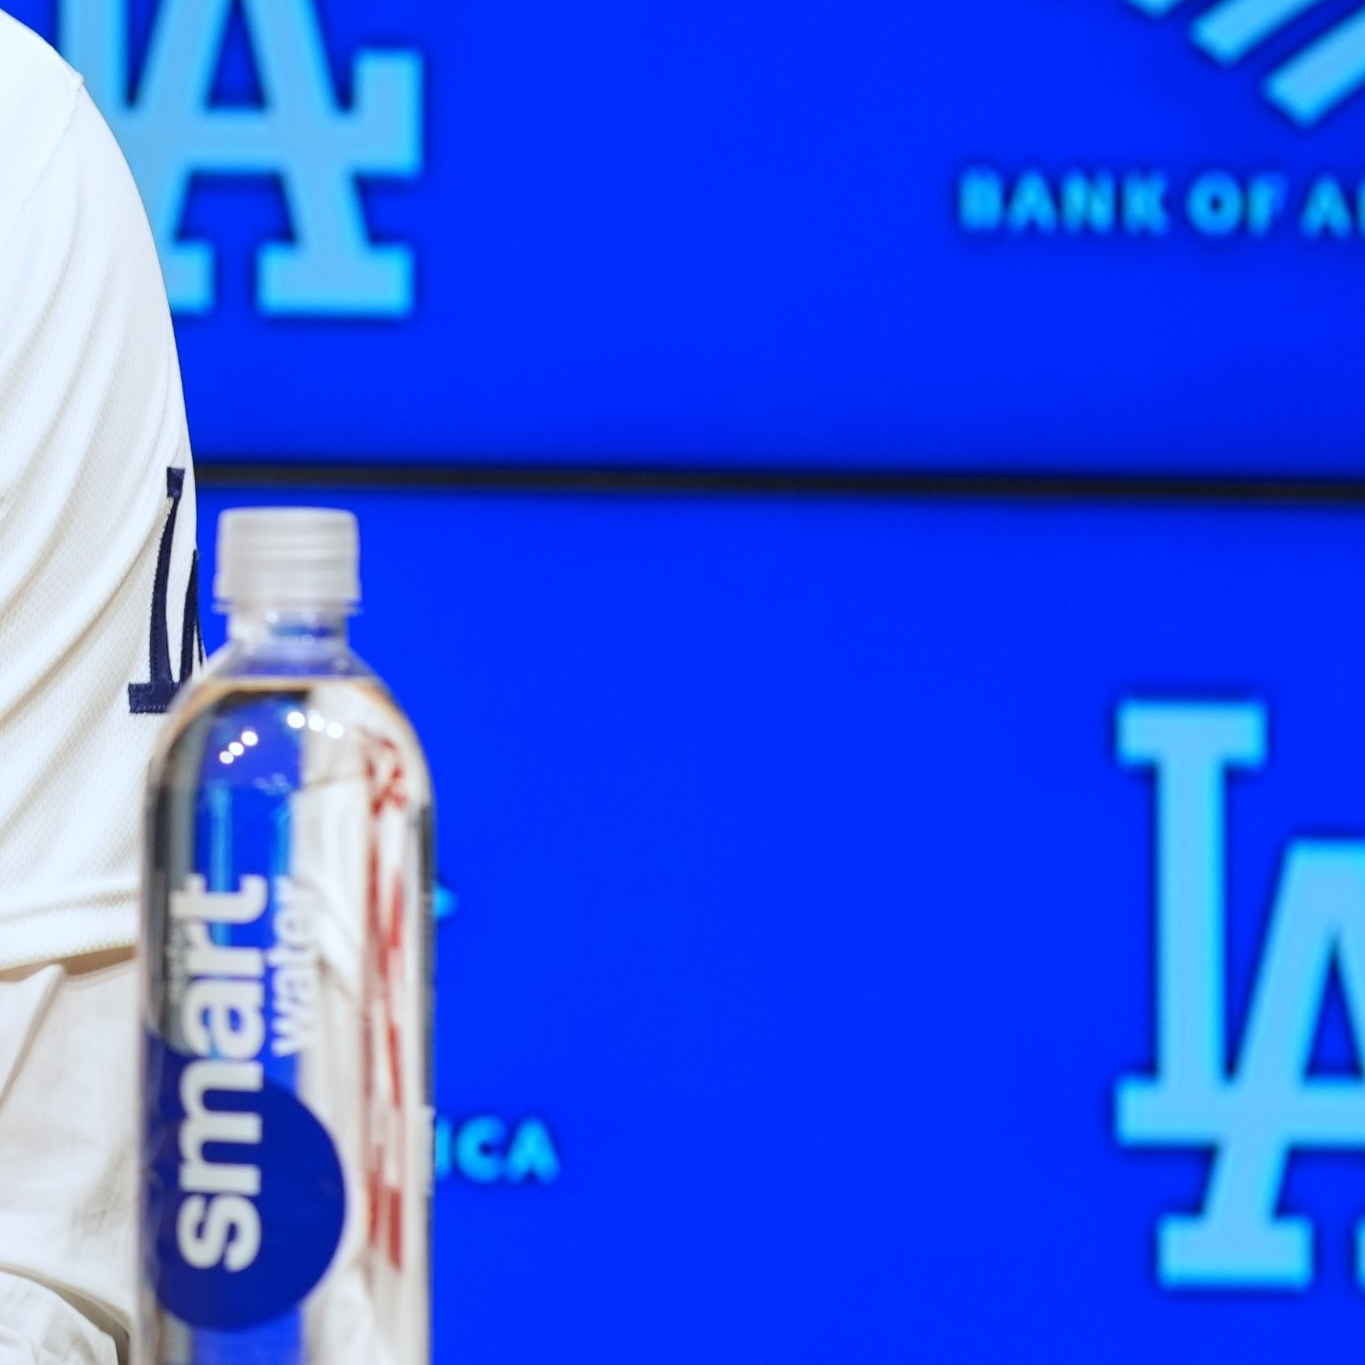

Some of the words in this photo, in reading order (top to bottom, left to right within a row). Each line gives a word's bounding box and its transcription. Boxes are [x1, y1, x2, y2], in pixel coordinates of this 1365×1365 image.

[958, 167, 1170, 238] BANK
[1186, 169, 1289, 239] OF
[266, 875, 315, 1058] water
[169, 873, 269, 1273] smart
